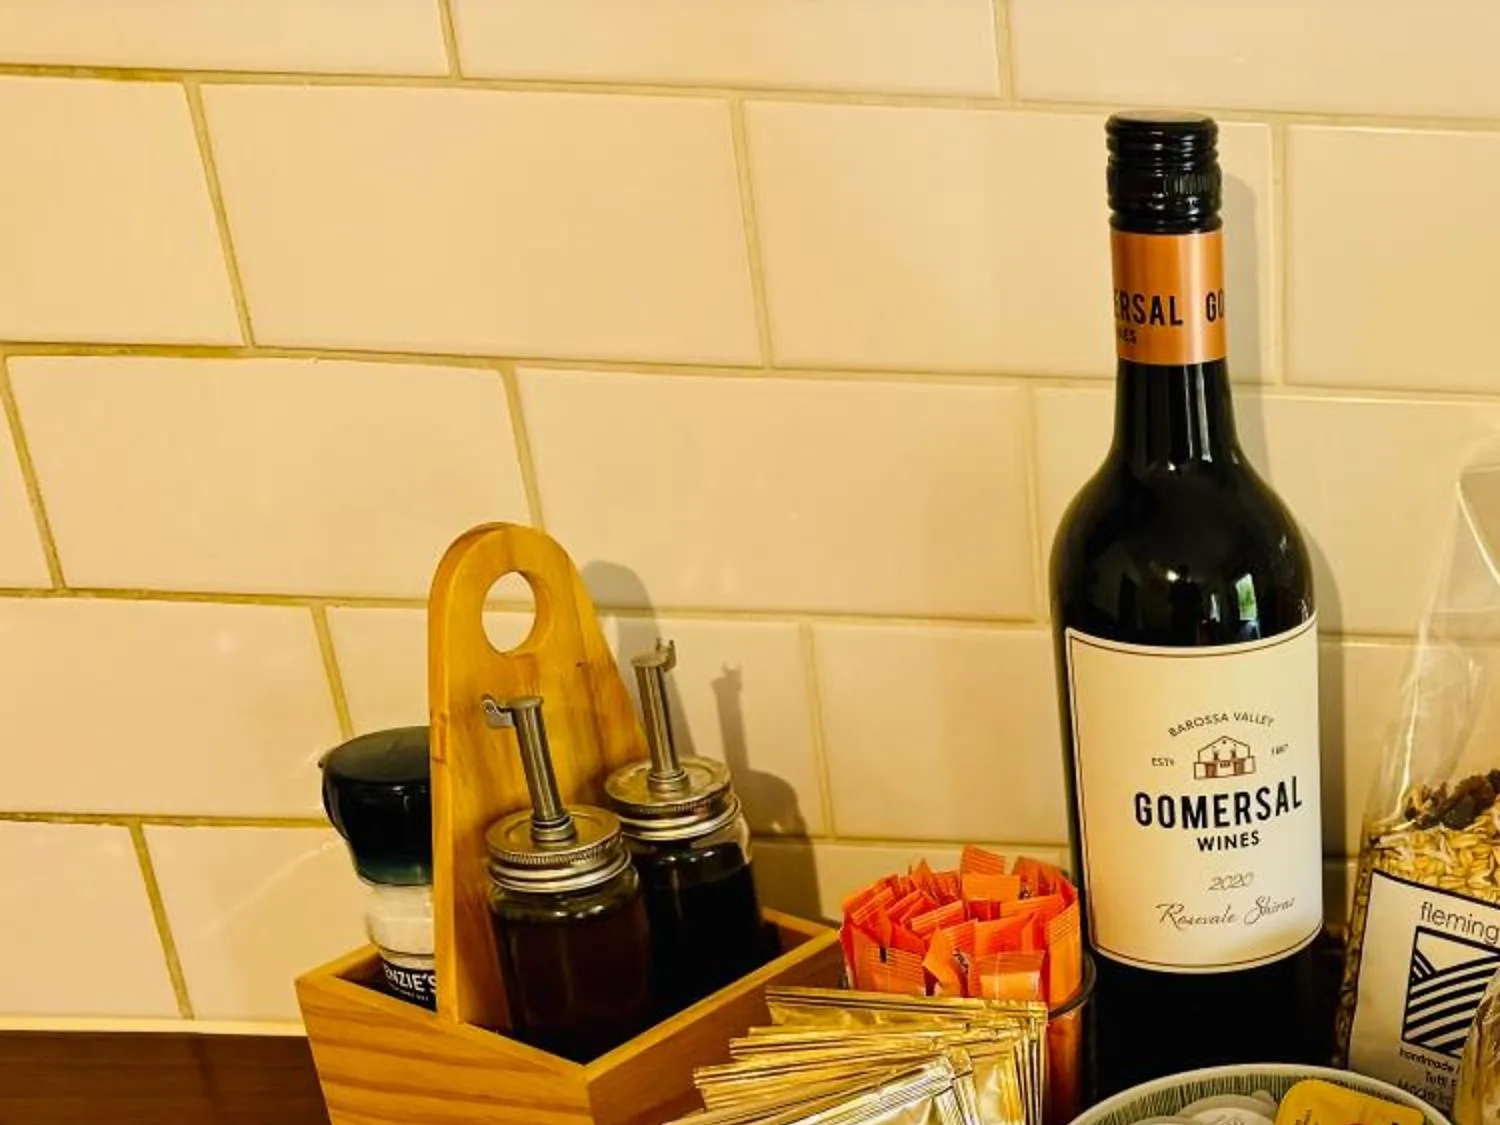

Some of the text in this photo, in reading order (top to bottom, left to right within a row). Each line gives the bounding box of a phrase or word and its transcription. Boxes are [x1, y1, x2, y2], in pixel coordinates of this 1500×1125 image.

[1167, 711, 1275, 737] BAROSSA VALLEY
[1134, 775, 1303, 829] GOMERSAL
[1197, 830, 1260, 852] WINES
[1208, 871, 1254, 891] 2020
[1420, 901, 1500, 946] fleming
